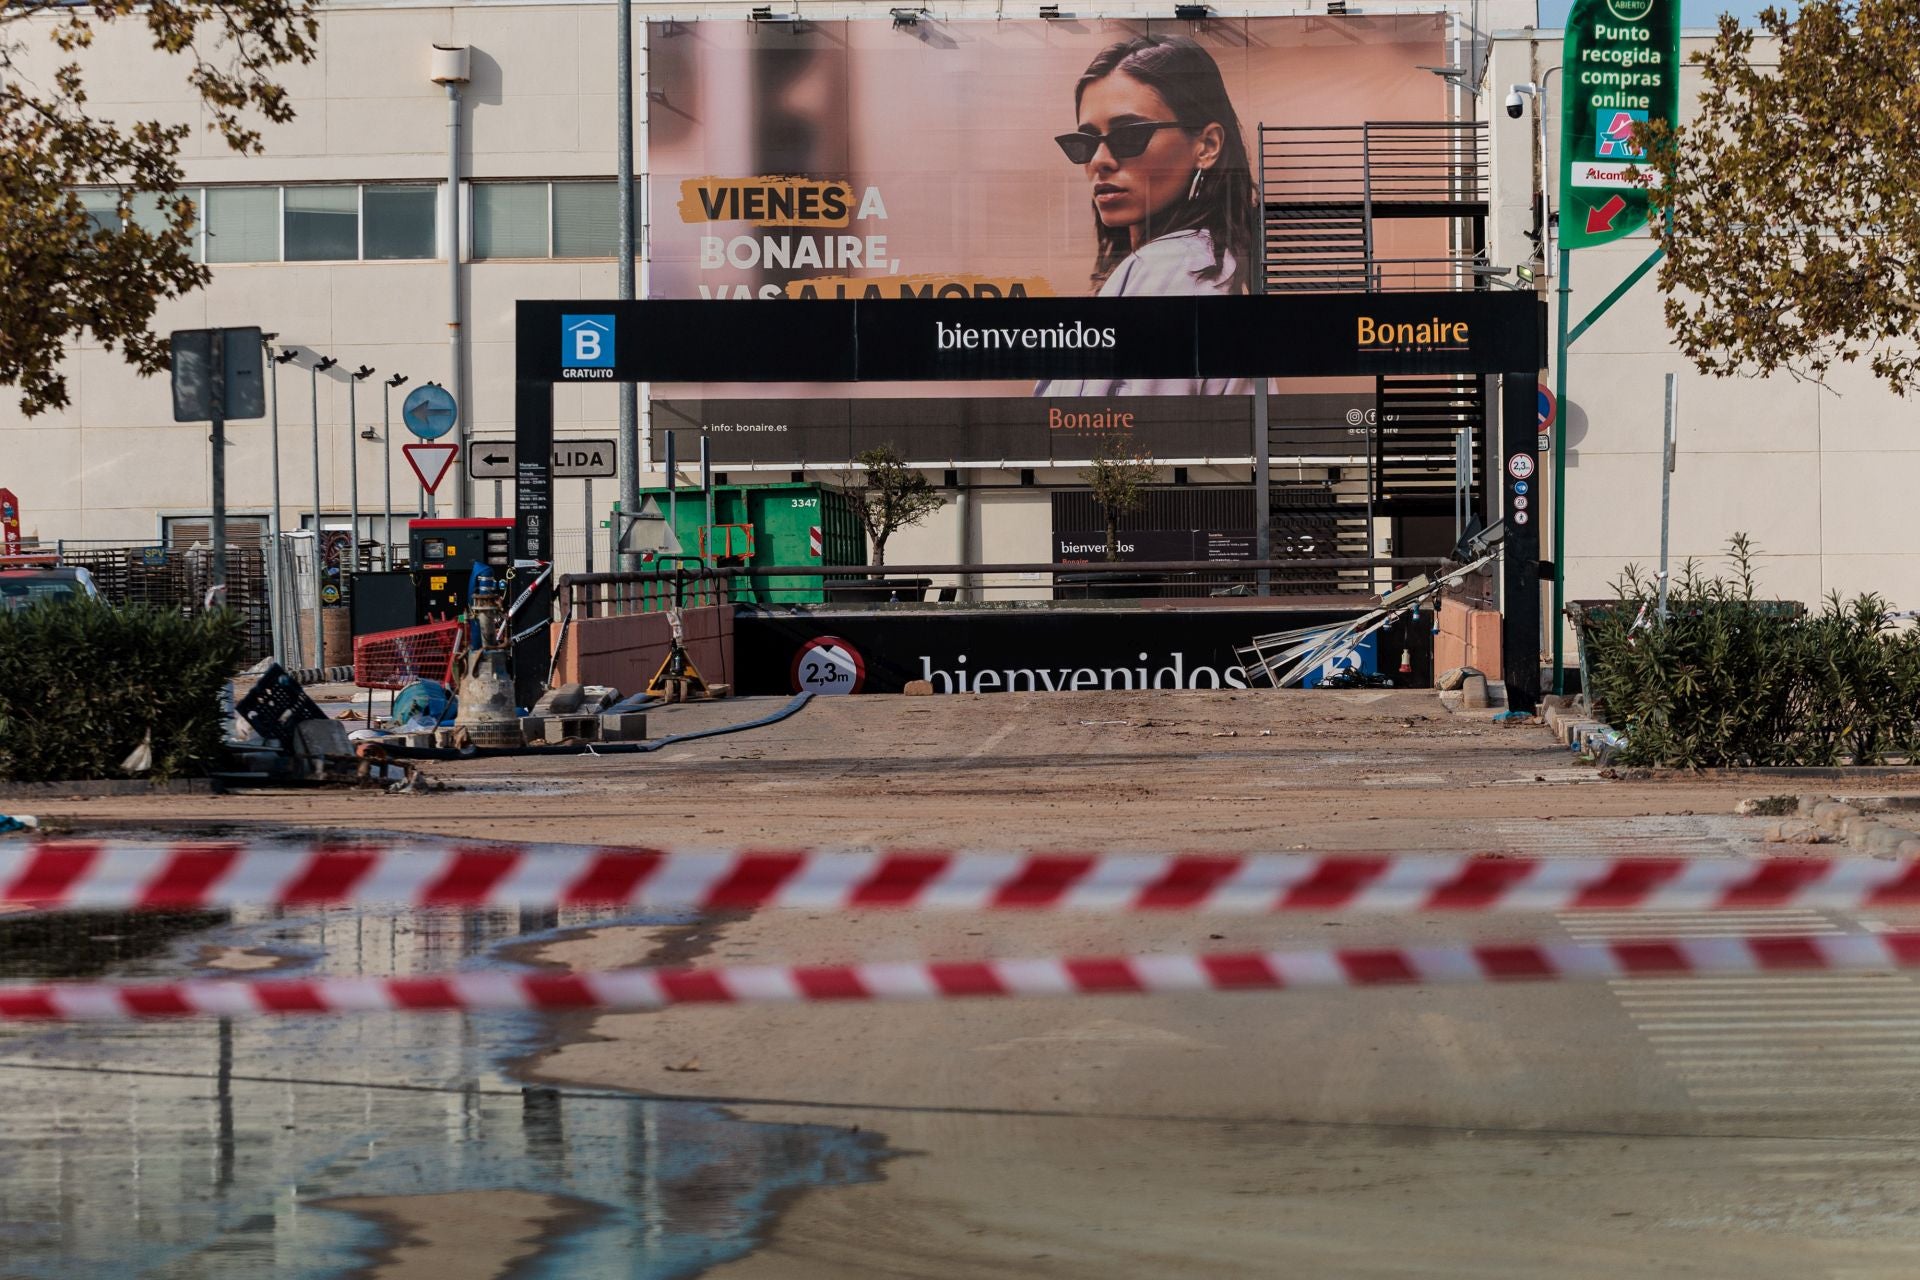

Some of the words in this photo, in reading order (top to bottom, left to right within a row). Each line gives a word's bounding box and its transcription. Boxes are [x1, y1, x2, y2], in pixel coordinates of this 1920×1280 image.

[1615, 1, 1646, 9] ABIERTO
[1595, 24, 1650, 41] Punto
[1582, 47, 1661, 67] recogida
[1581, 70, 1661, 89] compras
[1591, 91, 1650, 108] online
[698, 186, 847, 220] VIENES
[856, 186, 888, 220] A
[700, 235, 900, 274] BONAIRE,
[936, 321, 1116, 349] bienvenidos
[1358, 317, 1469, 344] Bonaire
[576, 330, 601, 360] B
[563, 368, 614, 378] GRATUITO
[711, 423, 734, 432] info:
[736, 423, 788, 432] bonaire.es
[1050, 408, 1134, 429] Bonaire
[554, 452, 604, 467] LIDA
[791, 499, 818, 507] 3347
[1060, 540, 1135, 553] bienvendos
[806, 662, 849, 686] 2,3m
